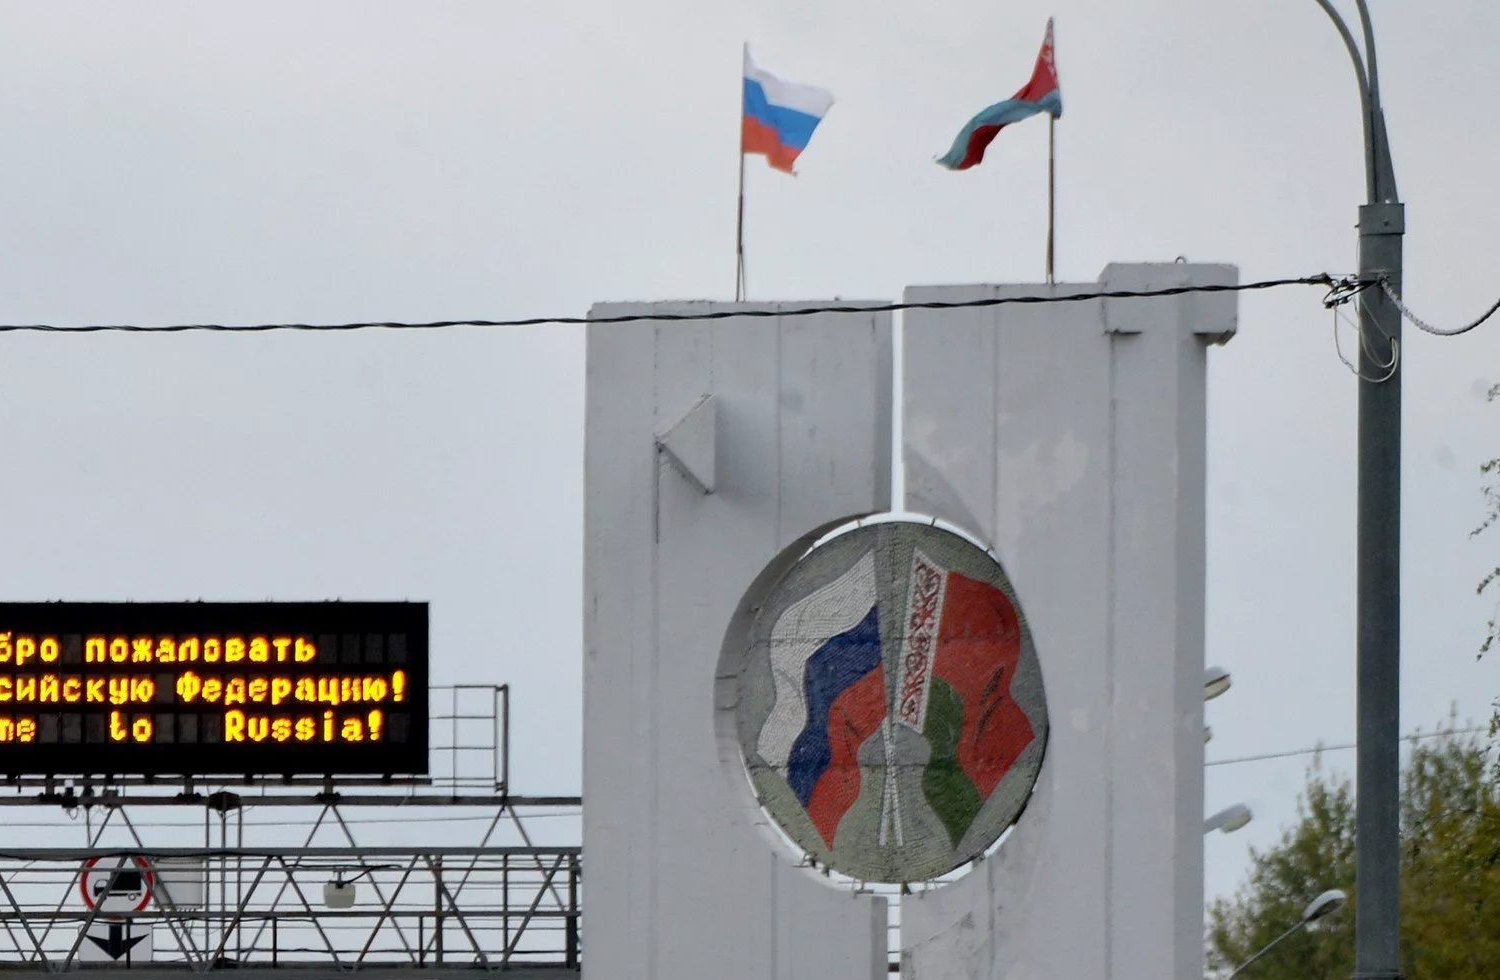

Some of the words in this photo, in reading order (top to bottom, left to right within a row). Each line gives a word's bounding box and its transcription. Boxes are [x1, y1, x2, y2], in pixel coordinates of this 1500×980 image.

[85, 635, 317, 664] пожаловать
[176, 670, 405, 704] Федерацию!
[109, 711, 153, 743] to
[225, 709, 384, 743] Russia!
